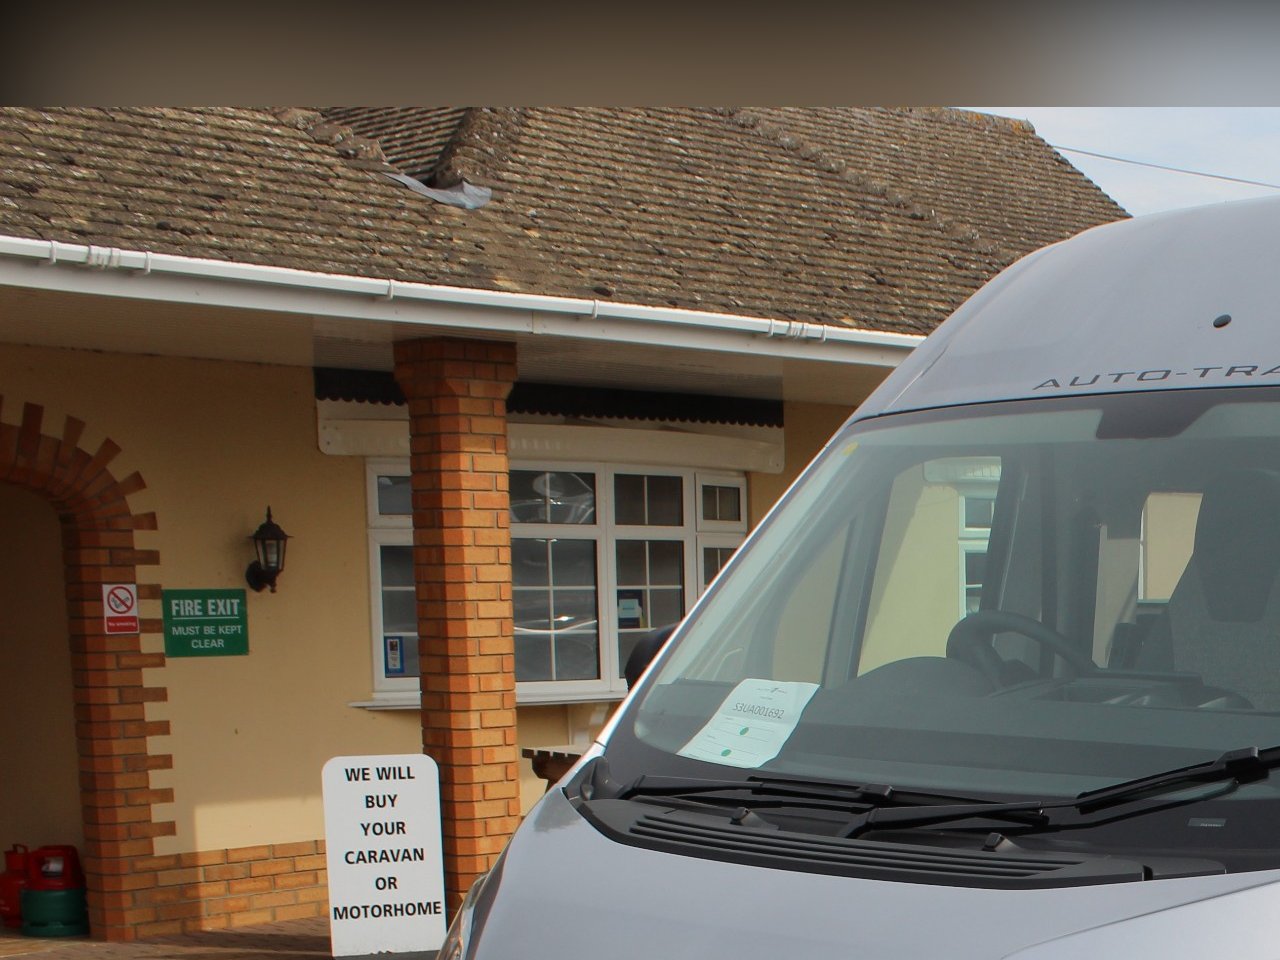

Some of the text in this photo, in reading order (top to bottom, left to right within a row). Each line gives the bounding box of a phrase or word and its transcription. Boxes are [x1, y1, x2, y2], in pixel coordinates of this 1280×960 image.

[171, 599, 240, 616] FIRE EXIT
[172, 625, 242, 636] MUST BE KEPT
[191, 639, 225, 649] CLEAR
[345, 766, 415, 782] WE WILL
[365, 794, 398, 809] BUY
[360, 821, 406, 836] YOUR
[344, 848, 424, 864] CARAVAN
[375, 876, 398, 890] OR
[333, 901, 442, 920] MOTORHOME
